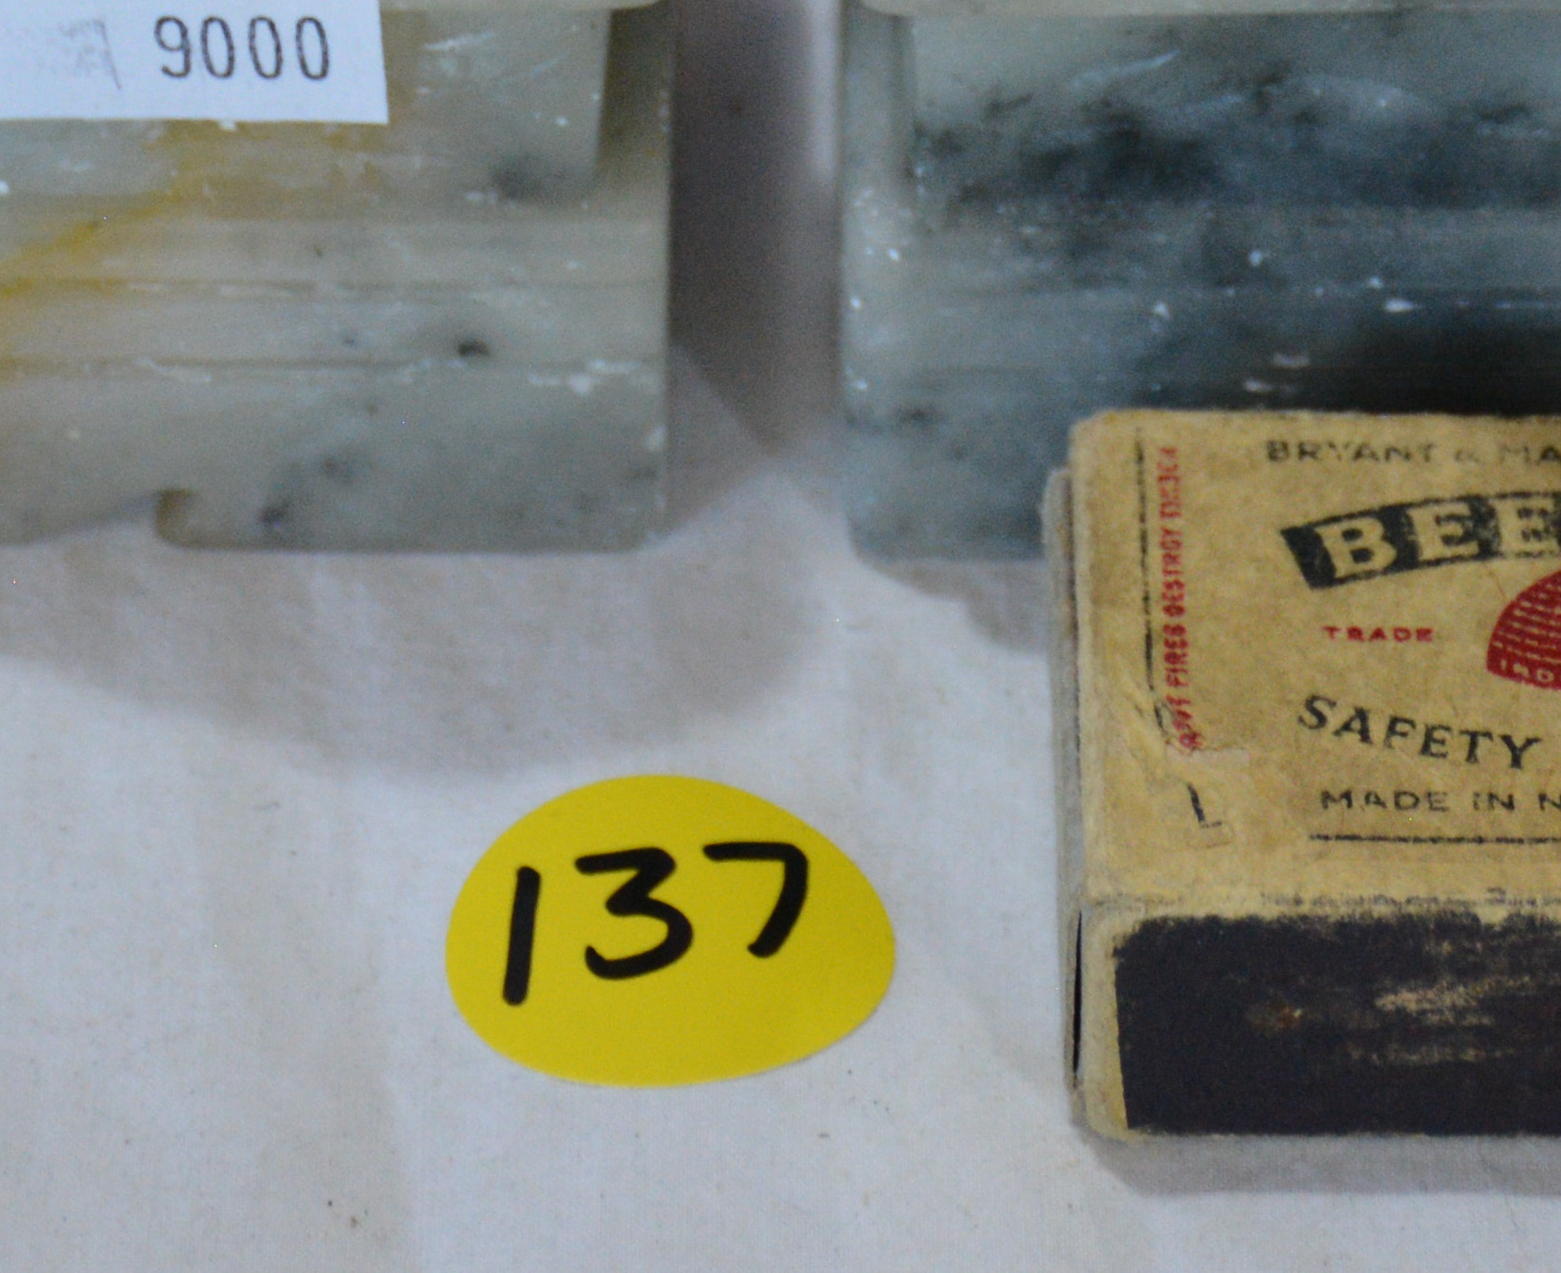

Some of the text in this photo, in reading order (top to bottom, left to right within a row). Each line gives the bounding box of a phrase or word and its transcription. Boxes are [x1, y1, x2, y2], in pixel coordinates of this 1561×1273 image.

[153, 15, 330, 81] 9000
[1266, 439, 1435, 464] BRYANT
[1159, 526, 1187, 618] DESTROY
[1322, 625, 1434, 643] TRADE
[1297, 693, 1542, 771] SAFETY
[1319, 789, 1450, 814] MADE
[1473, 790, 1516, 814] IN
[501, 840, 810, 1007] 137
